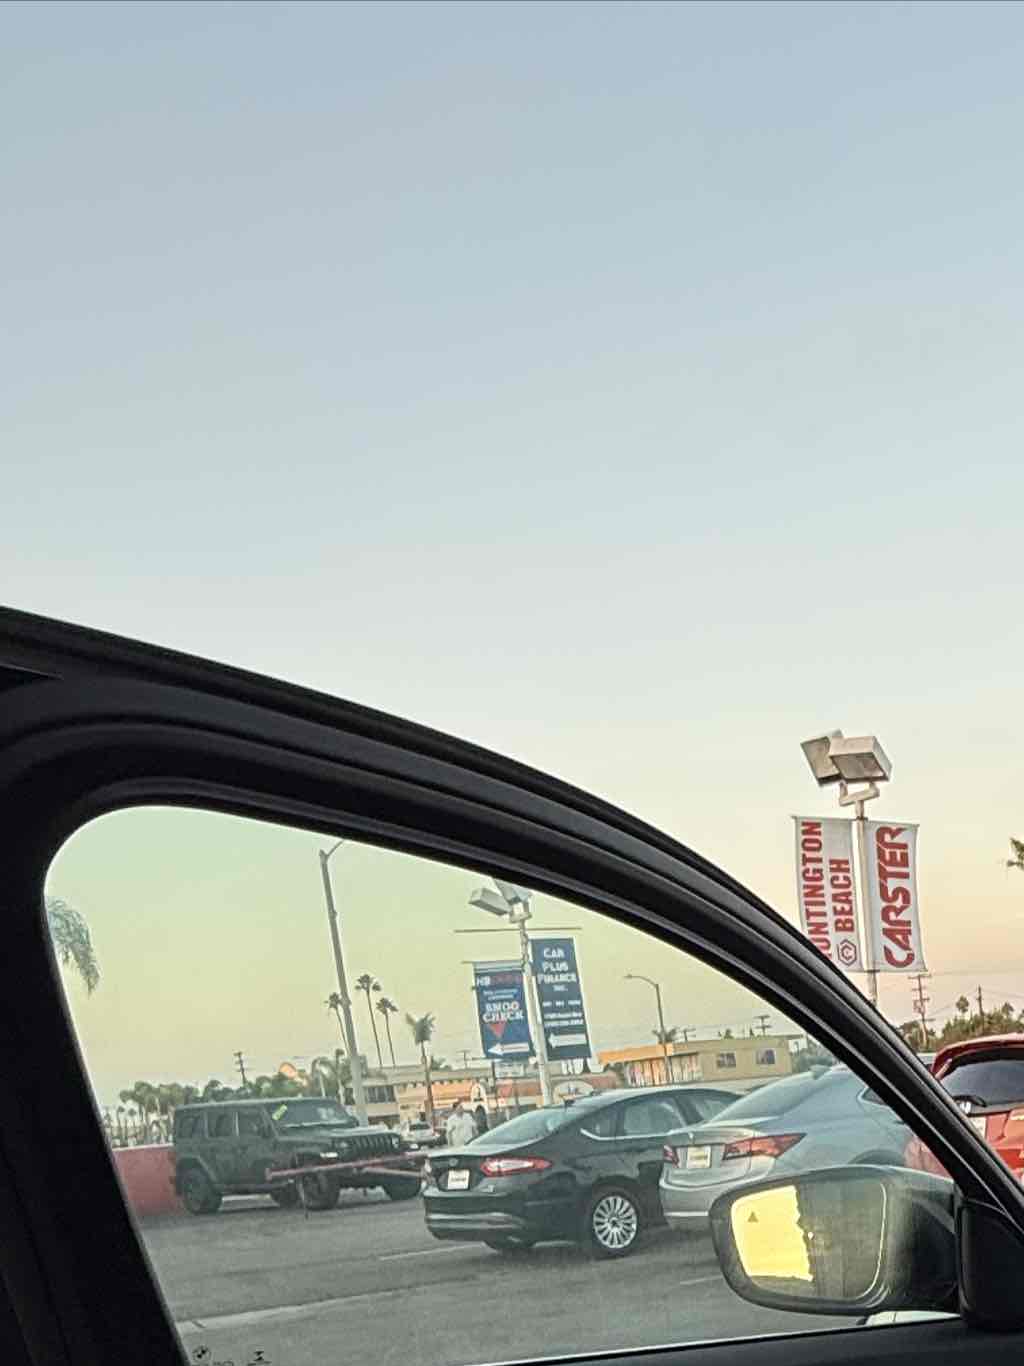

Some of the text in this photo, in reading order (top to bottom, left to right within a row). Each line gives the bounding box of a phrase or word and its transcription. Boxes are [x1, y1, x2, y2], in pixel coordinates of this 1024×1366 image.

[801, 821, 832, 960] UNTINGTON
[829, 859, 855, 933] BEACH
[876, 825, 915, 968] CARSTER
[482, 1010, 525, 1023] CHECK
